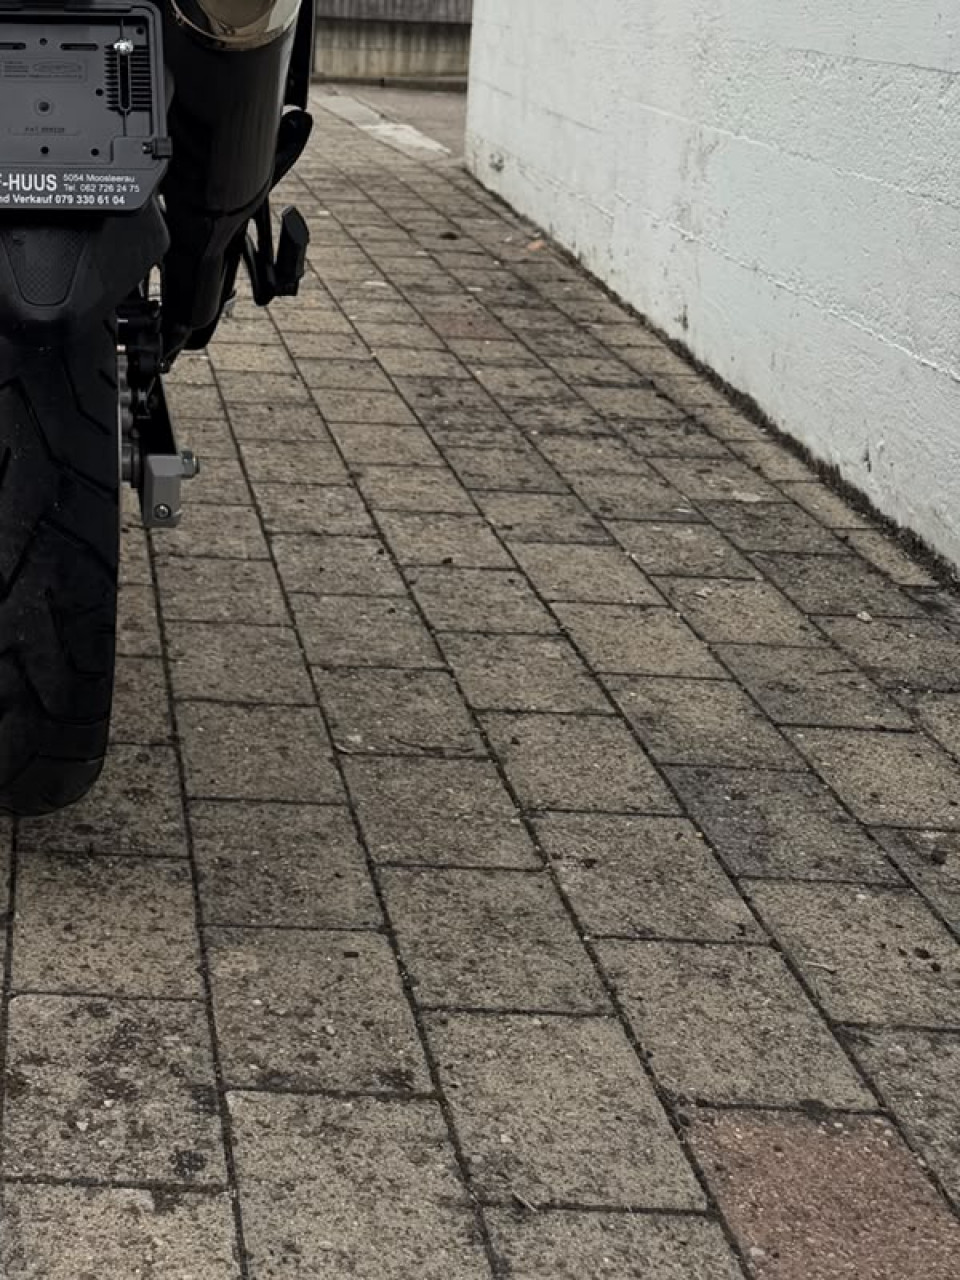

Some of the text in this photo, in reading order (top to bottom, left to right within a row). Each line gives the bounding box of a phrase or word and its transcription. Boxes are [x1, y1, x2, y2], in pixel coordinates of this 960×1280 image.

[63, 173, 135, 183] 5054 Moosleerau
[80, 184, 96, 192] 062
[12, 194, 52, 204] Verkauf
[55, 195, 73, 204] 079
[76, 195, 94, 205] 330
[97, 195, 110, 205] 61
[113, 195, 125, 205] 04
